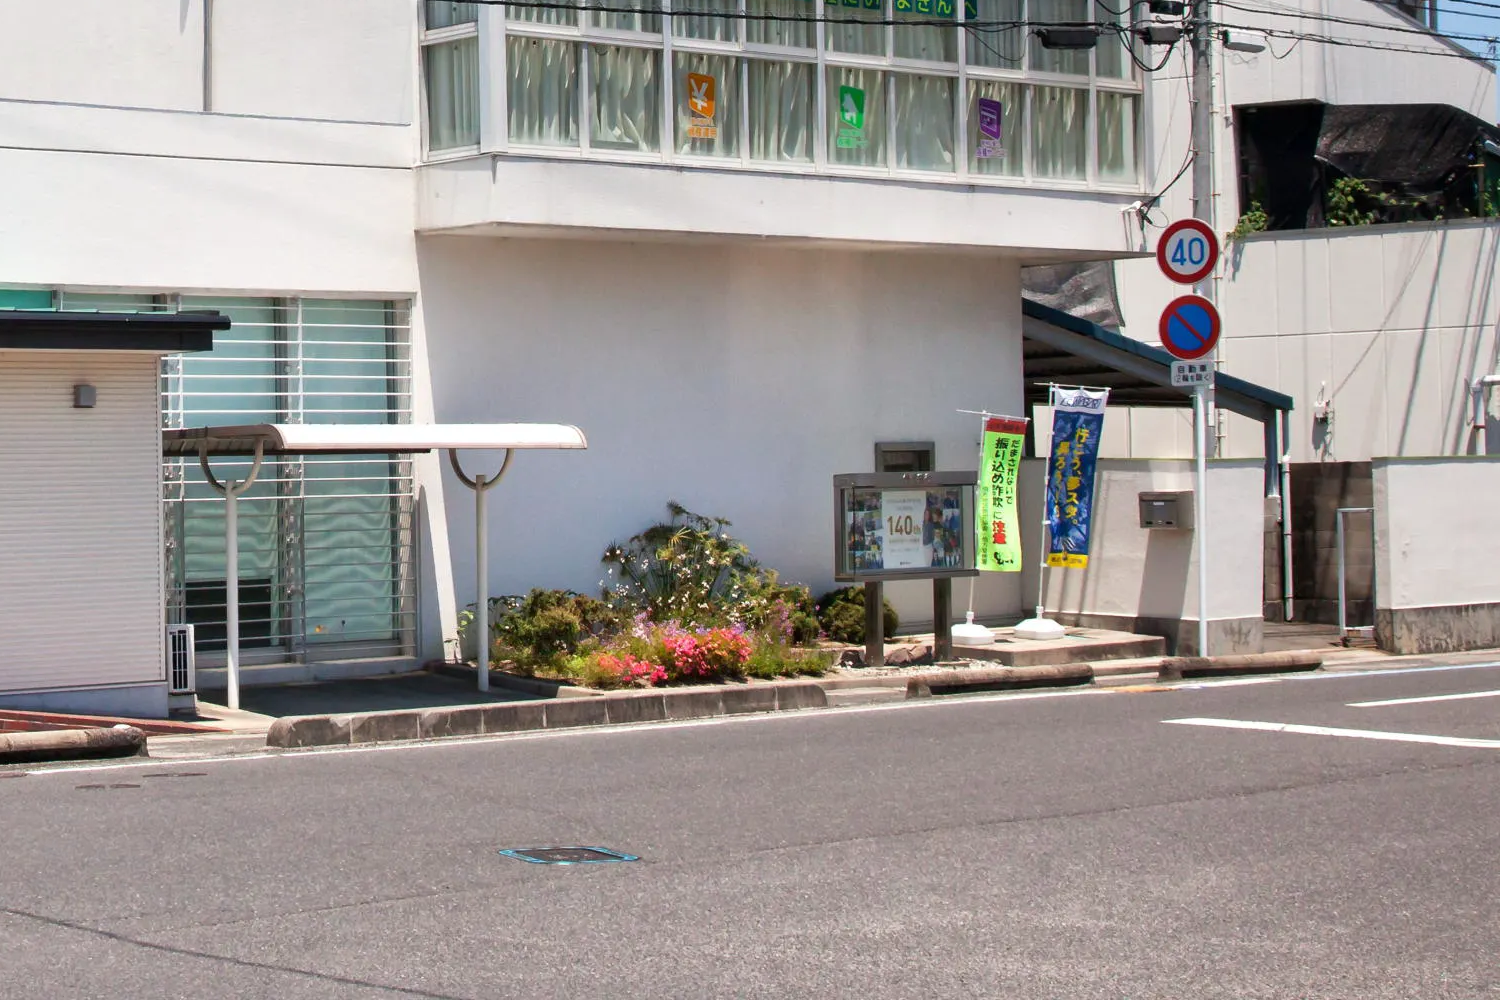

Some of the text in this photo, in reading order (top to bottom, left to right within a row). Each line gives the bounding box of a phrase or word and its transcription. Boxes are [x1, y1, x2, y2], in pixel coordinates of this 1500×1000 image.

[1171, 237, 1205, 266] 40
[1005, 439, 1021, 505] だまされないで
